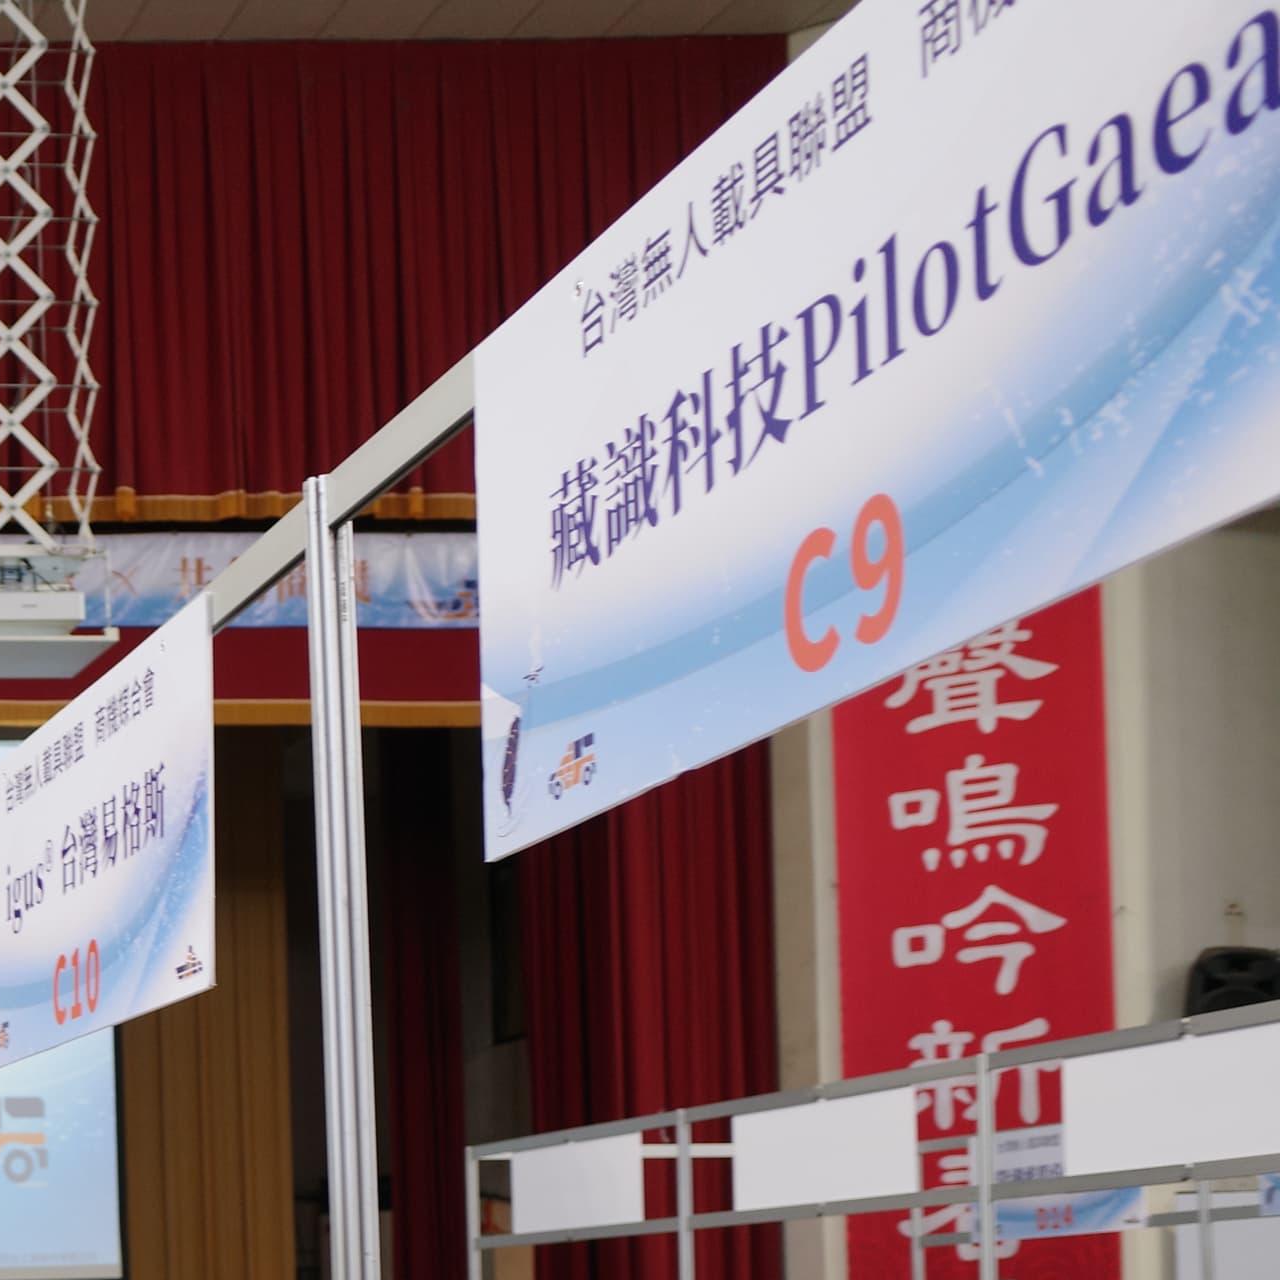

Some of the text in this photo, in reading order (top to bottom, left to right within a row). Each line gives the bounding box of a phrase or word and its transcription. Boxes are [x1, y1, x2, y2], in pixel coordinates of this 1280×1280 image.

[578, 53, 873, 358] 台灣無人載具聯盟
[784, 492, 905, 673] C9
[61, 761, 167, 895] 台灣易格斯
[52, 938, 101, 1026] C10
